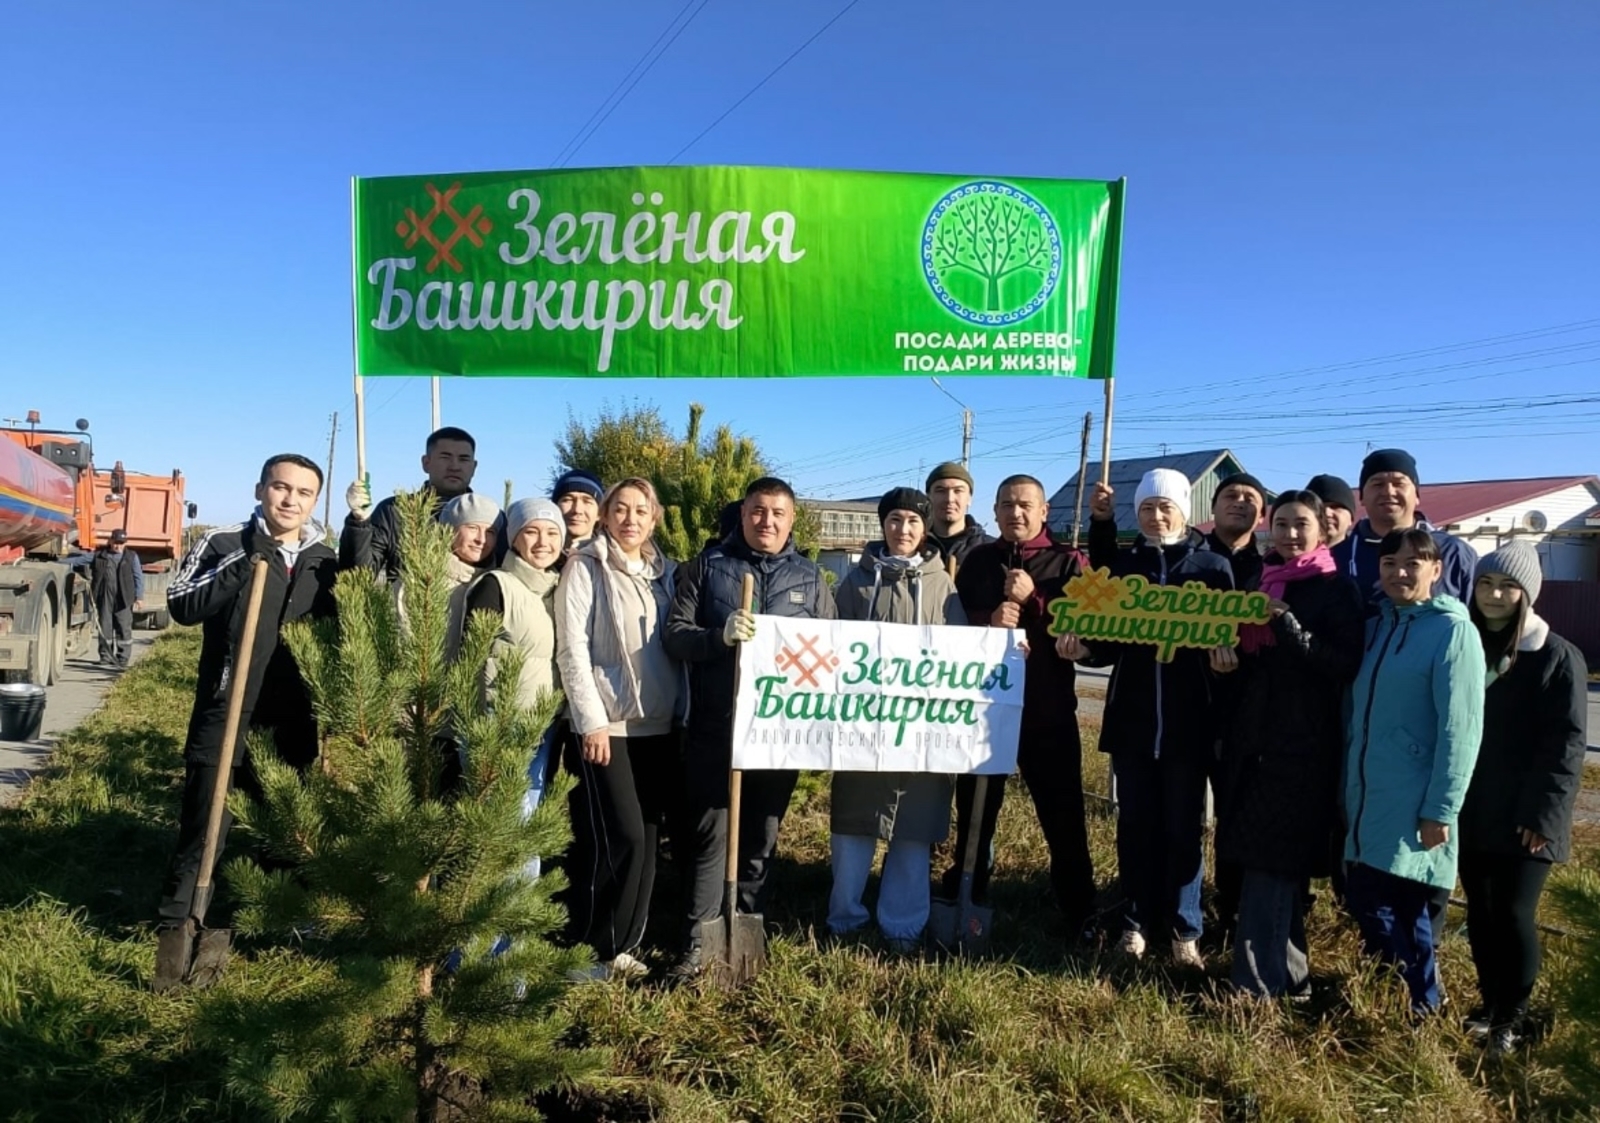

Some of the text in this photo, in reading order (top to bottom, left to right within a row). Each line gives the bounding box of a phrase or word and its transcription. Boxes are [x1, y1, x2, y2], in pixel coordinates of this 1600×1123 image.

[498, 188, 806, 265] Зелёная
[367, 256, 743, 372] Башкирия
[895, 332, 1082, 350] ПОСАДИ ДЕРЕВО-
[904, 354, 993, 372] ПОДАРИ
[1119, 577, 1269, 619] Зелёная
[1051, 601, 1235, 662] Башкирия
[842, 642, 1013, 691] Зелёная
[754, 676, 978, 747] Башкирия
